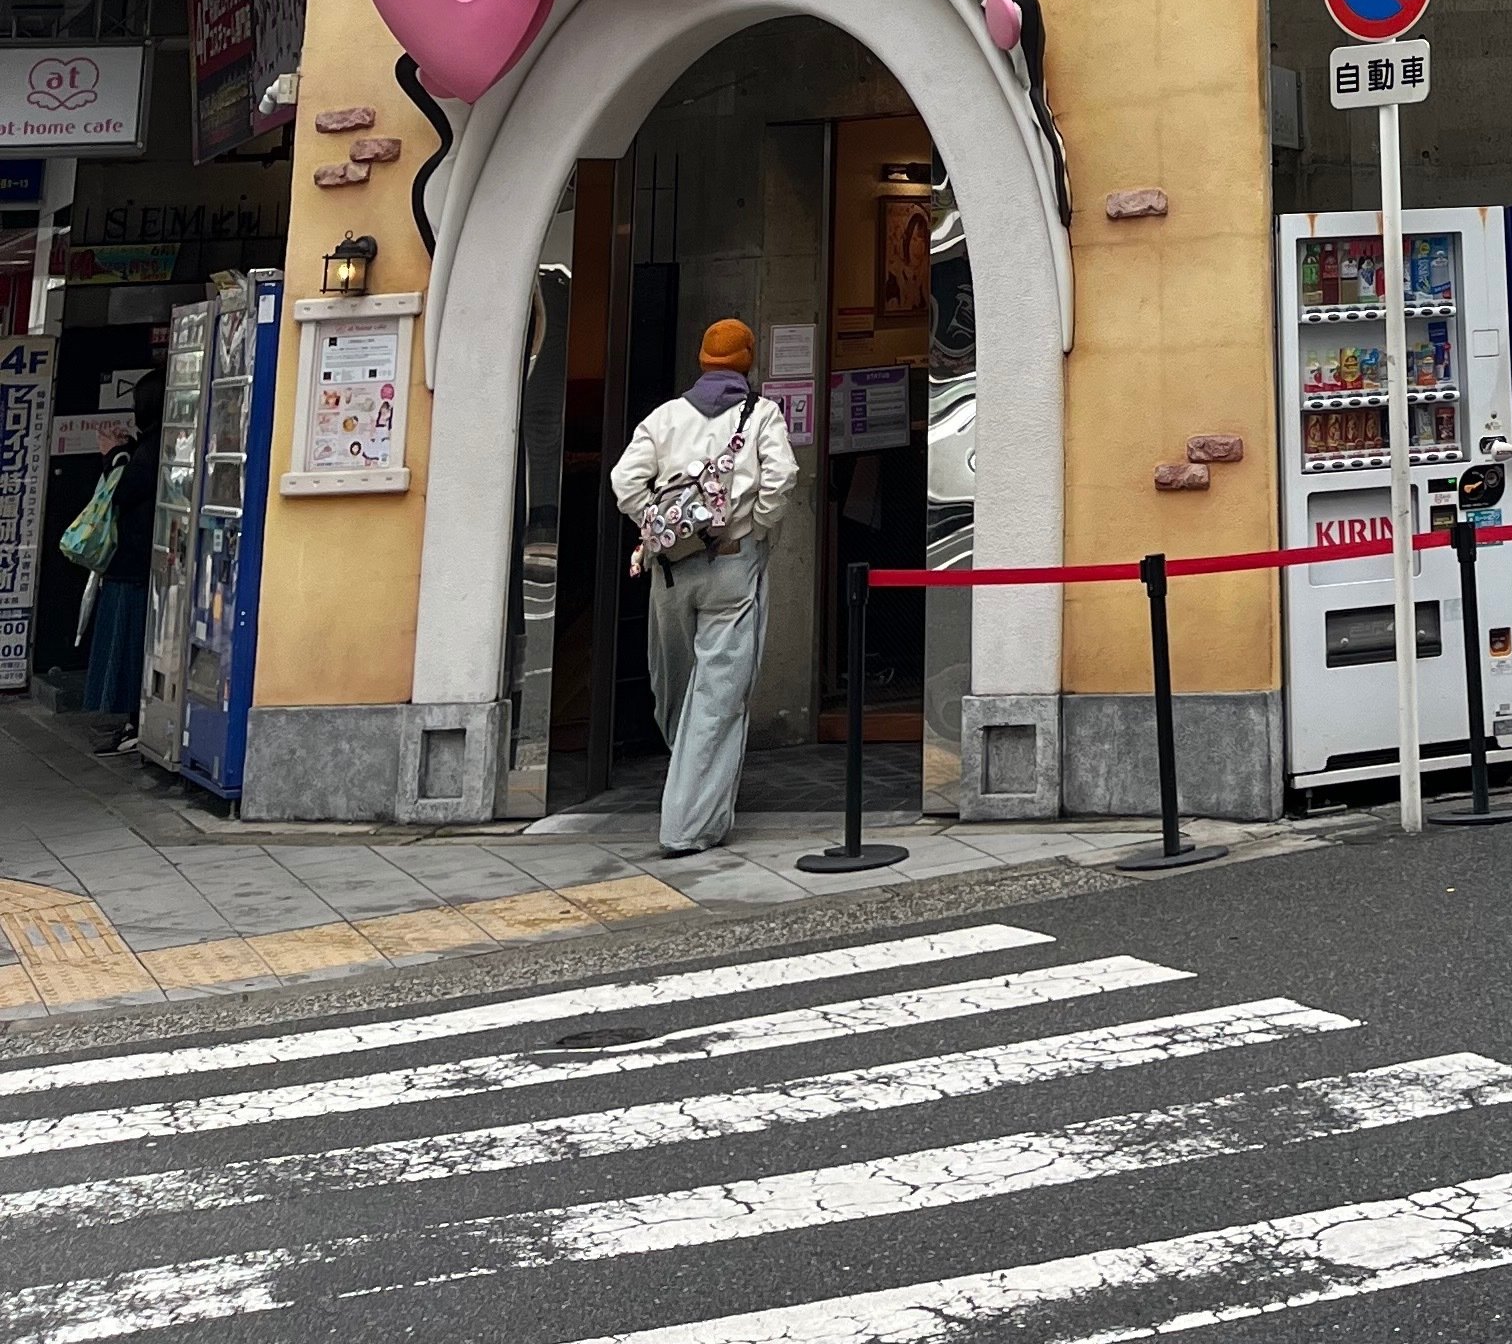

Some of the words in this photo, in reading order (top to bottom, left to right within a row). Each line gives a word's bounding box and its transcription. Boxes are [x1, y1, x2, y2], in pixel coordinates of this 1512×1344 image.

[46, 66, 81, 90] at
[1336, 55, 1426, 96] 自動車
[84, 117, 123, 135] cafe
[0, 345, 49, 376] 4F
